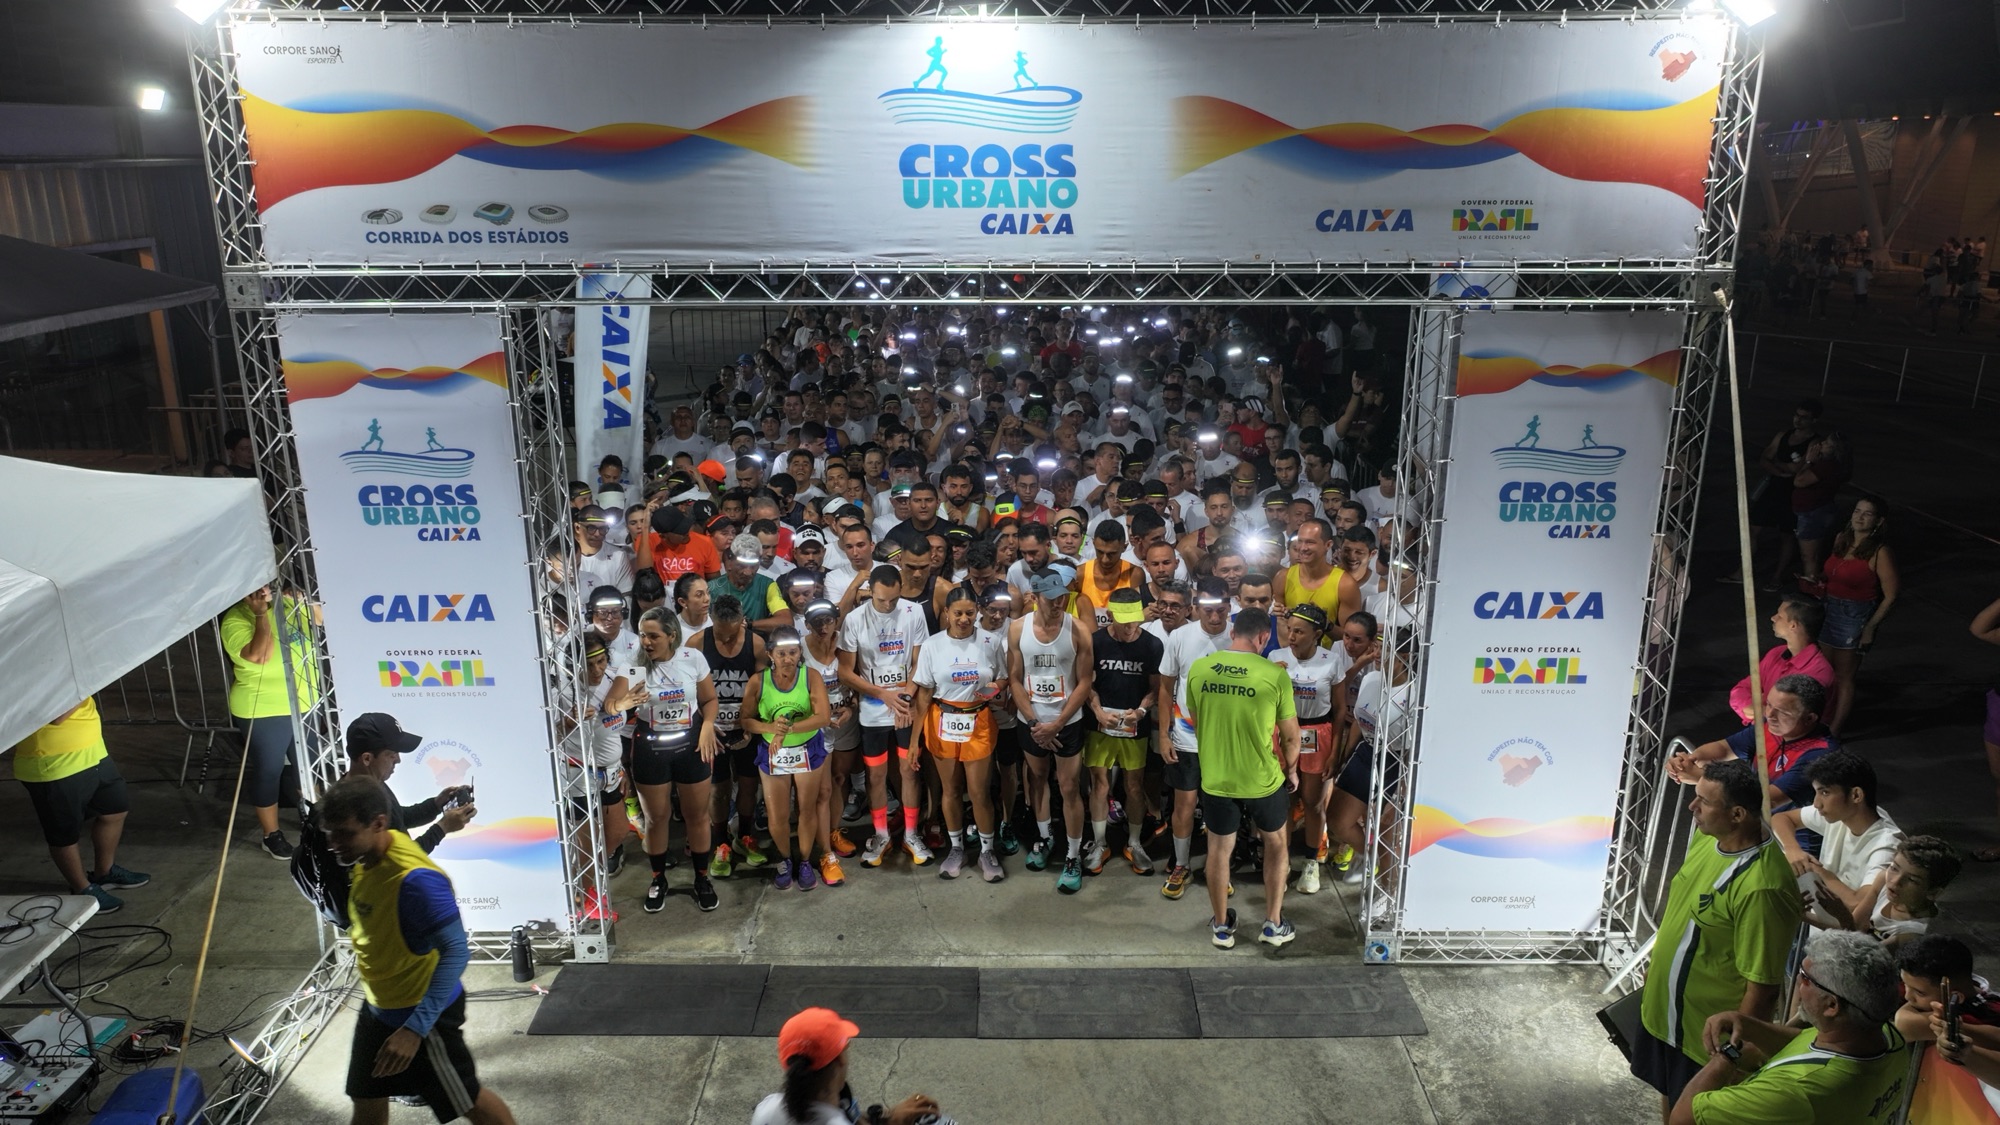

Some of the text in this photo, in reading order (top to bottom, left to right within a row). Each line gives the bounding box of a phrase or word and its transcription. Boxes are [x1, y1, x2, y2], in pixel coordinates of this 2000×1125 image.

[263, 46, 336, 55] CORPORE SANO
[1648, 34, 1674, 57] RESPEITO
[898, 144, 1076, 178] CROSS
[902, 178, 1078, 209] URBANO
[980, 213, 1074, 234] CAIXA
[1316, 208, 1414, 232] CAIXA
[1452, 208, 1538, 232] BRASIL
[365, 228, 570, 244] CORRIDA DOS ESTÁDIOS
[602, 290, 632, 430] CAIXA
[358, 484, 478, 506] CROSS
[1498, 481, 1616, 503] CROSS
[362, 506, 481, 526] URBANO
[1498, 503, 1616, 522] URBANO
[417, 528, 481, 542] CAIXA
[1548, 524, 1610, 538] CAIXA
[662, 557, 694, 570] RACE
[362, 594, 496, 622] CAIXA
[1473, 592, 1604, 620] CAIXA
[878, 640, 904, 648] CROSS
[378, 659, 496, 687] BRASIL
[952, 670, 979, 678] CROSS
[1100, 660, 1144, 672] STARK
[1473, 656, 1588, 684] BRASIL
[878, 672, 902, 684] 1055
[658, 688, 684, 697] CROSS
[1036, 684, 1056, 692] 250
[1200, 680, 1256, 698] ÁRBITRO
[658, 709, 684, 720] 1627
[946, 721, 970, 730] 1804
[414, 741, 439, 765] RESPEITO
[458, 742, 472, 754] TEM
[471, 753, 482, 768] COR
[776, 754, 802, 764] 2328
[1488, 738, 1516, 762] RESPEITO
[1534, 740, 1547, 752] TEM
[1544, 750, 1554, 766] COR
